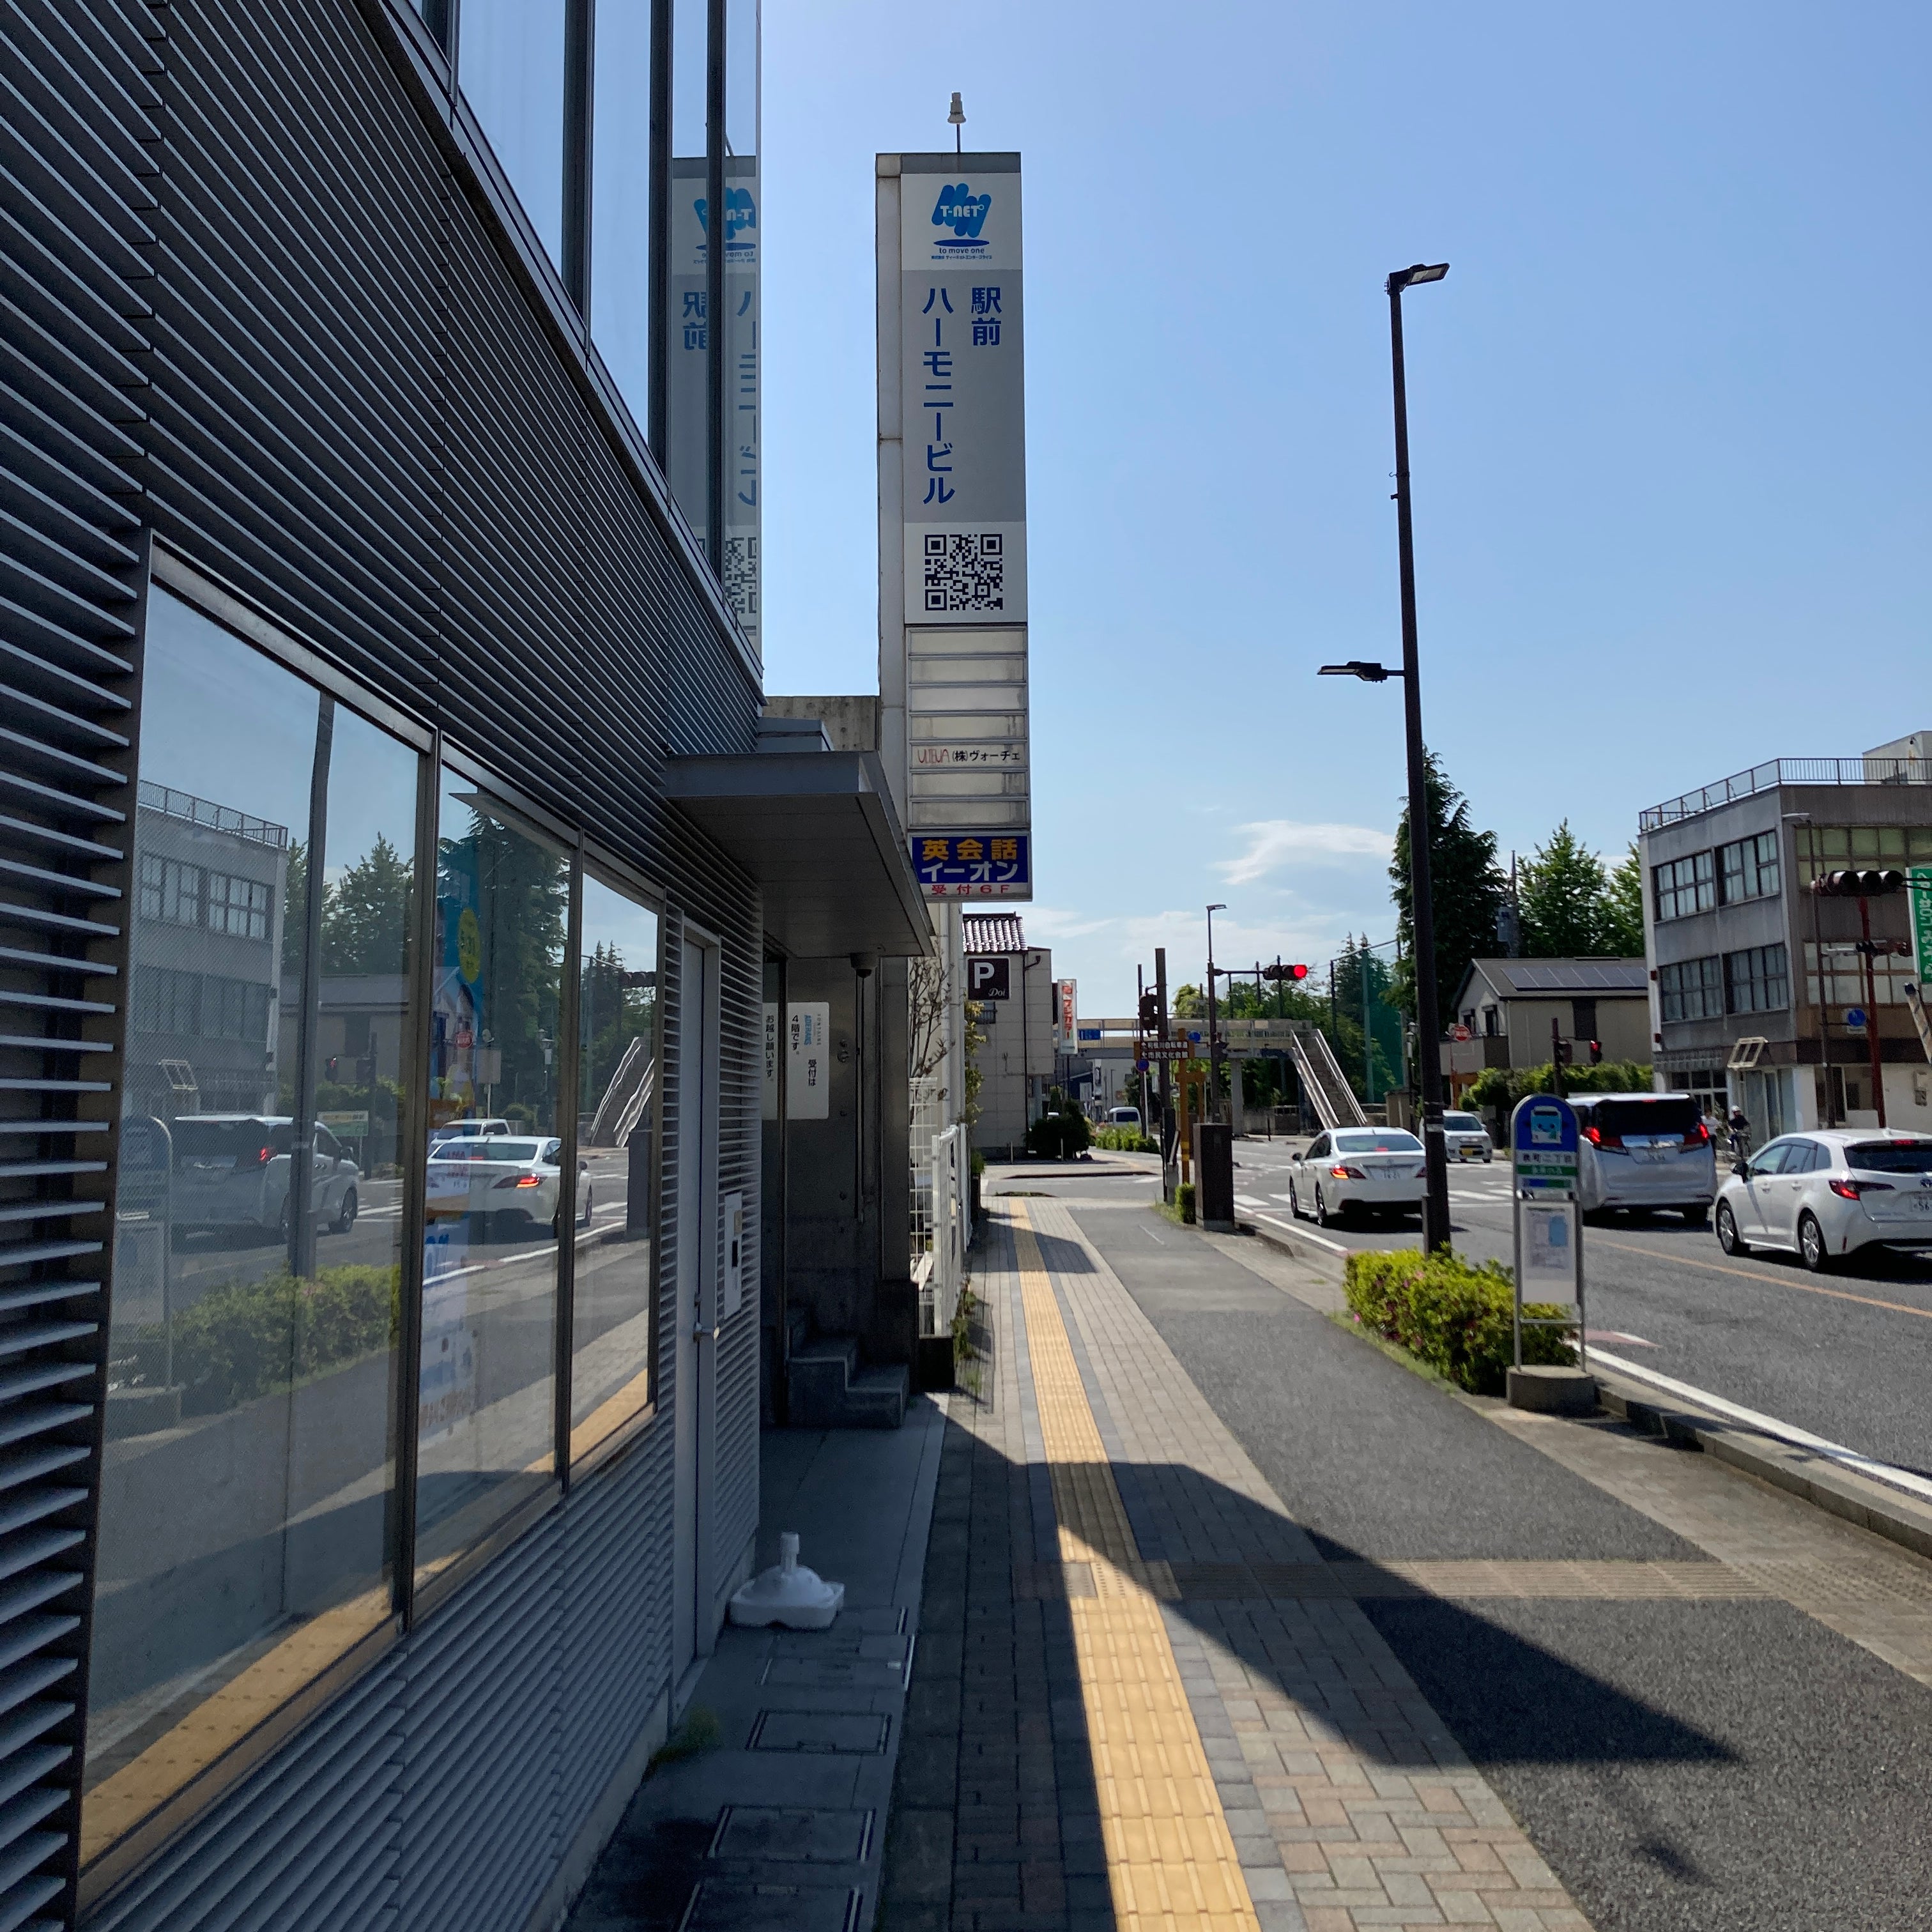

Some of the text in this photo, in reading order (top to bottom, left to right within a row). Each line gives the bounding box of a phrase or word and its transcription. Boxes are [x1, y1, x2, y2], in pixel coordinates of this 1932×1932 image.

[971, 287, 1002, 346] 駅前
[922, 288, 955, 505] ハーモニービル
[922, 838, 1018, 861] 英会話
[921, 861, 1018, 882] イーオン
[974, 962, 995, 989] P
[808, 1059, 817, 1086] 受付は
